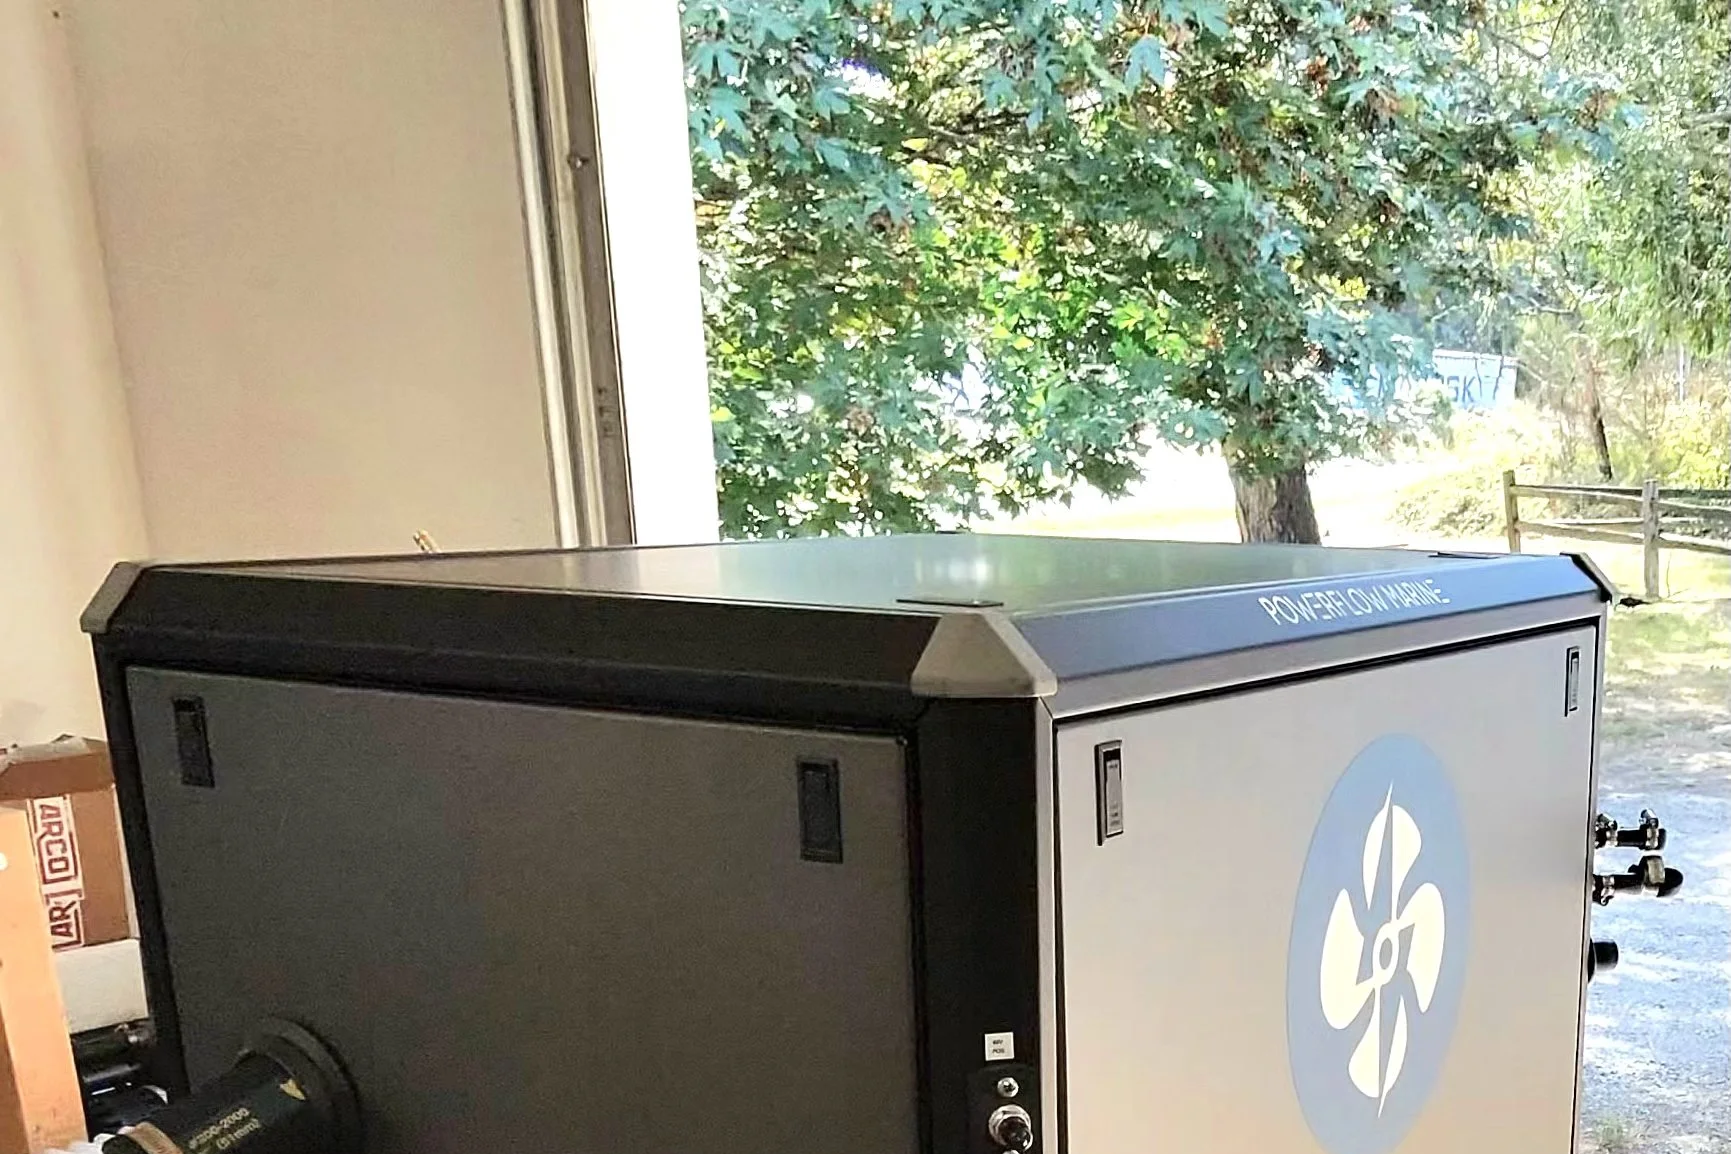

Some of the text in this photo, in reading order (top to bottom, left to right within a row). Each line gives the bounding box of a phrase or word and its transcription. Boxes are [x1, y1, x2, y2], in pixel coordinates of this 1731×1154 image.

[1258, 579, 1450, 625] POWERFLOW MARINE
[39, 803, 70, 874] ARCO
[50, 900, 77, 938] AR
